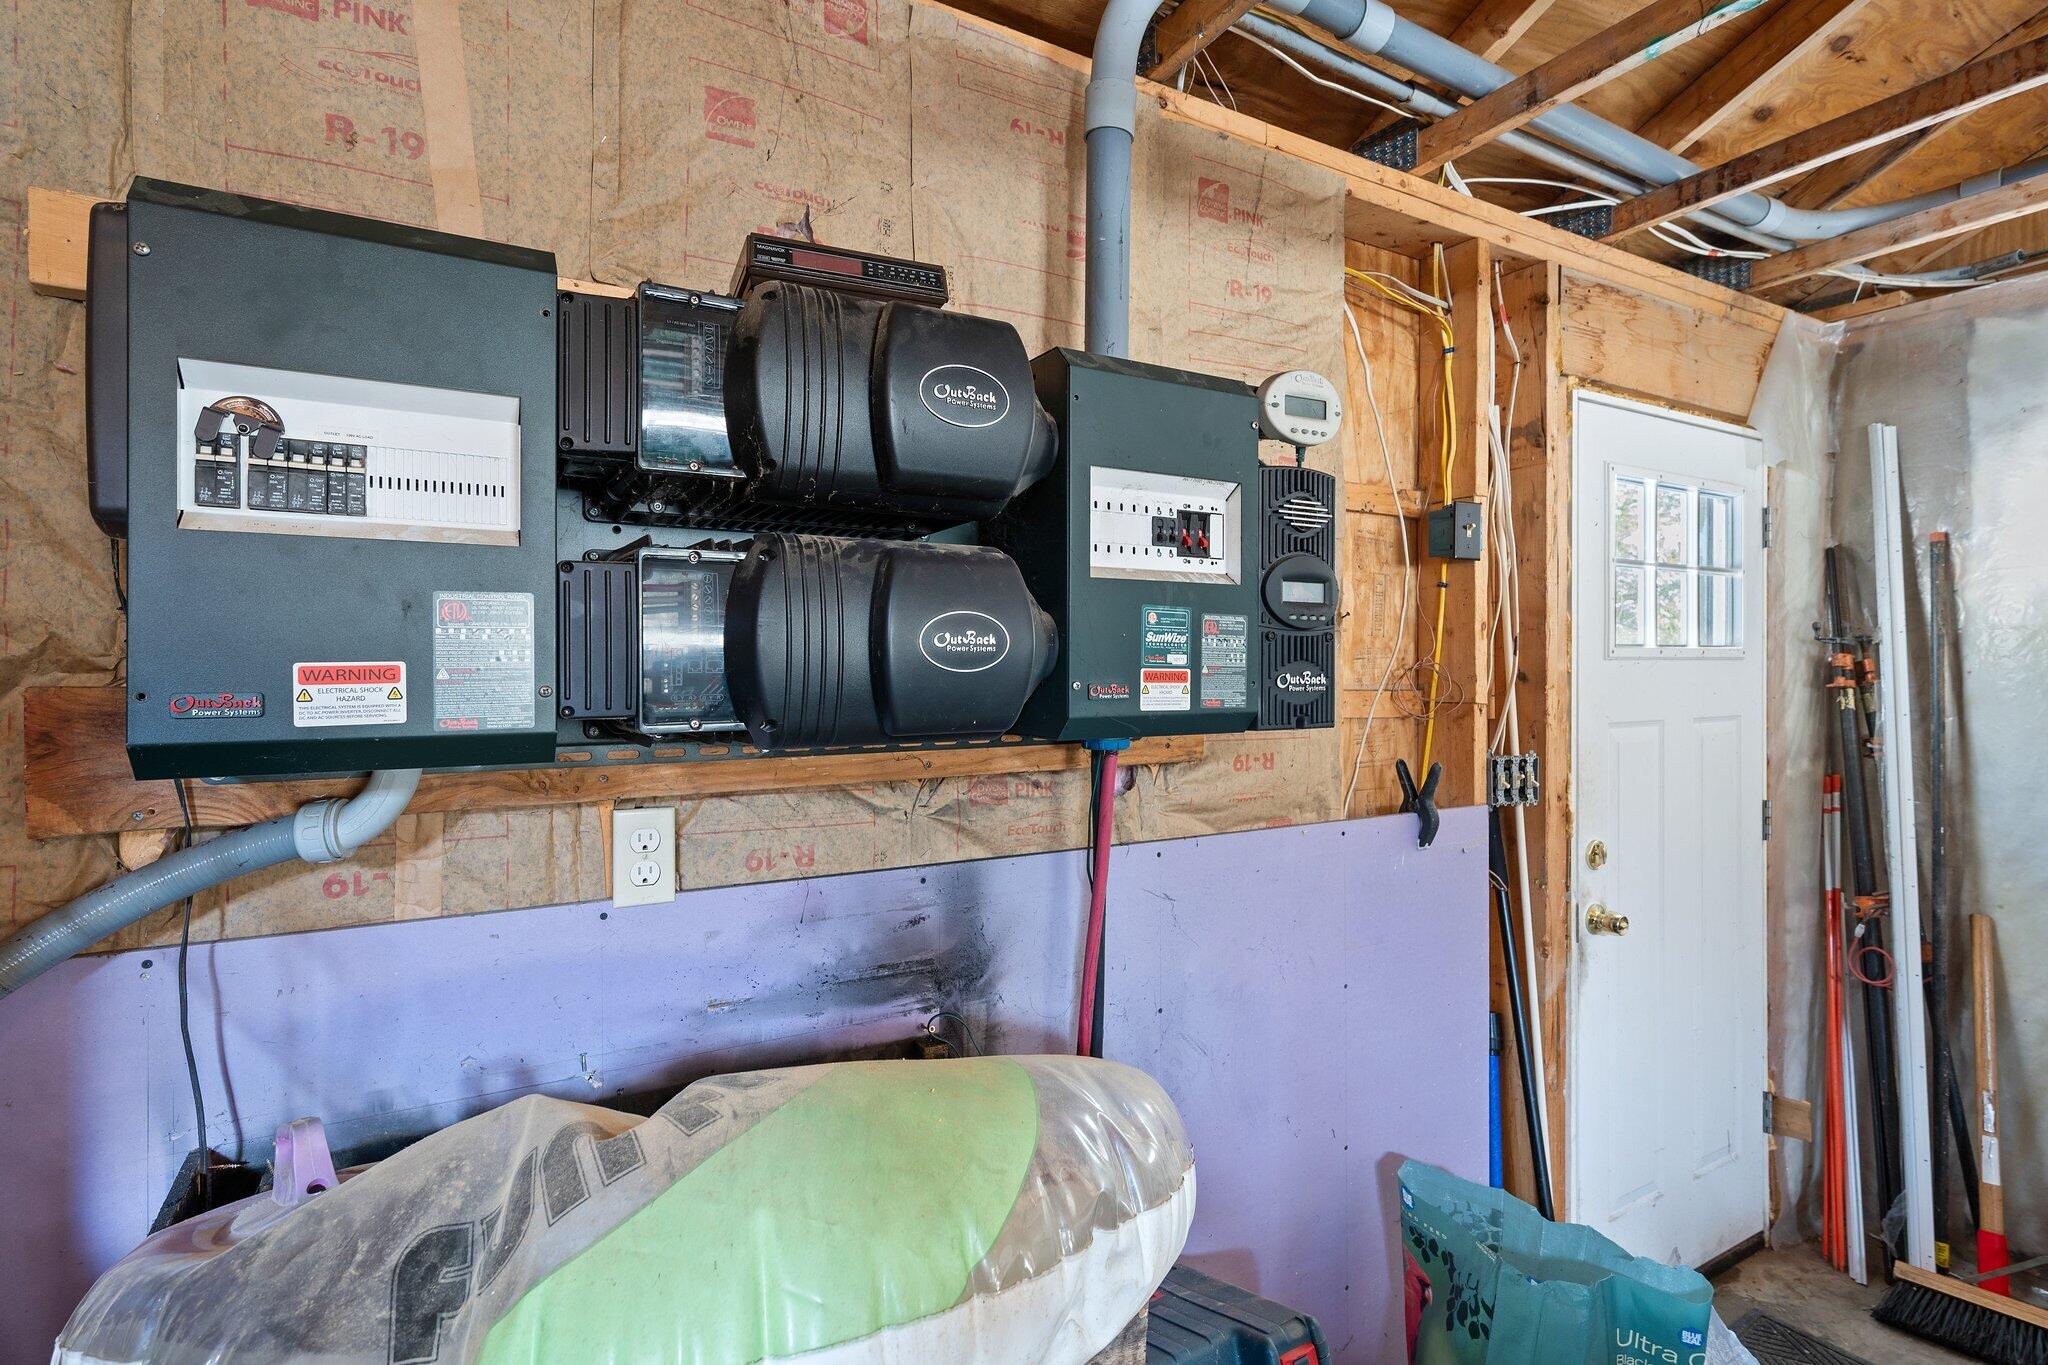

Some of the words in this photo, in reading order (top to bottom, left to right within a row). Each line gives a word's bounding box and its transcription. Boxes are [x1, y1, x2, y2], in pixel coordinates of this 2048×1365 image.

[334, 0, 409, 36] PINK
[716, 115, 755, 132] OWENS
[324, 112, 426, 161] R-19
[1233, 206, 1264, 228] PINK
[756, 244, 786, 253] MAGNAVOX
[1229, 279, 1272, 304] R-19
[933, 384, 996, 404] OutBack
[946, 397, 968, 406] Power
[969, 400, 996, 411] Systems
[933, 630, 996, 648] OutBack
[1145, 631, 1187, 643] SunWize
[969, 645, 996, 653] Systems
[302, 668, 396, 682] WARNING
[1144, 672, 1187, 681] WARNING
[1277, 670, 1326, 689] OutBack
[1089, 682, 1130, 697] OutBack
[1306, 684, 1326, 693] Systems
[169, 691, 262, 714] OutBack
[224, 708, 261, 717] Systems
[1233, 752, 1274, 772] R-19
[1007, 821, 1066, 837] EcoTouch
[745, 841, 815, 873] R-19
[322, 871, 389, 899] -19
[1616, 1328, 1678, 1364] Ultra
